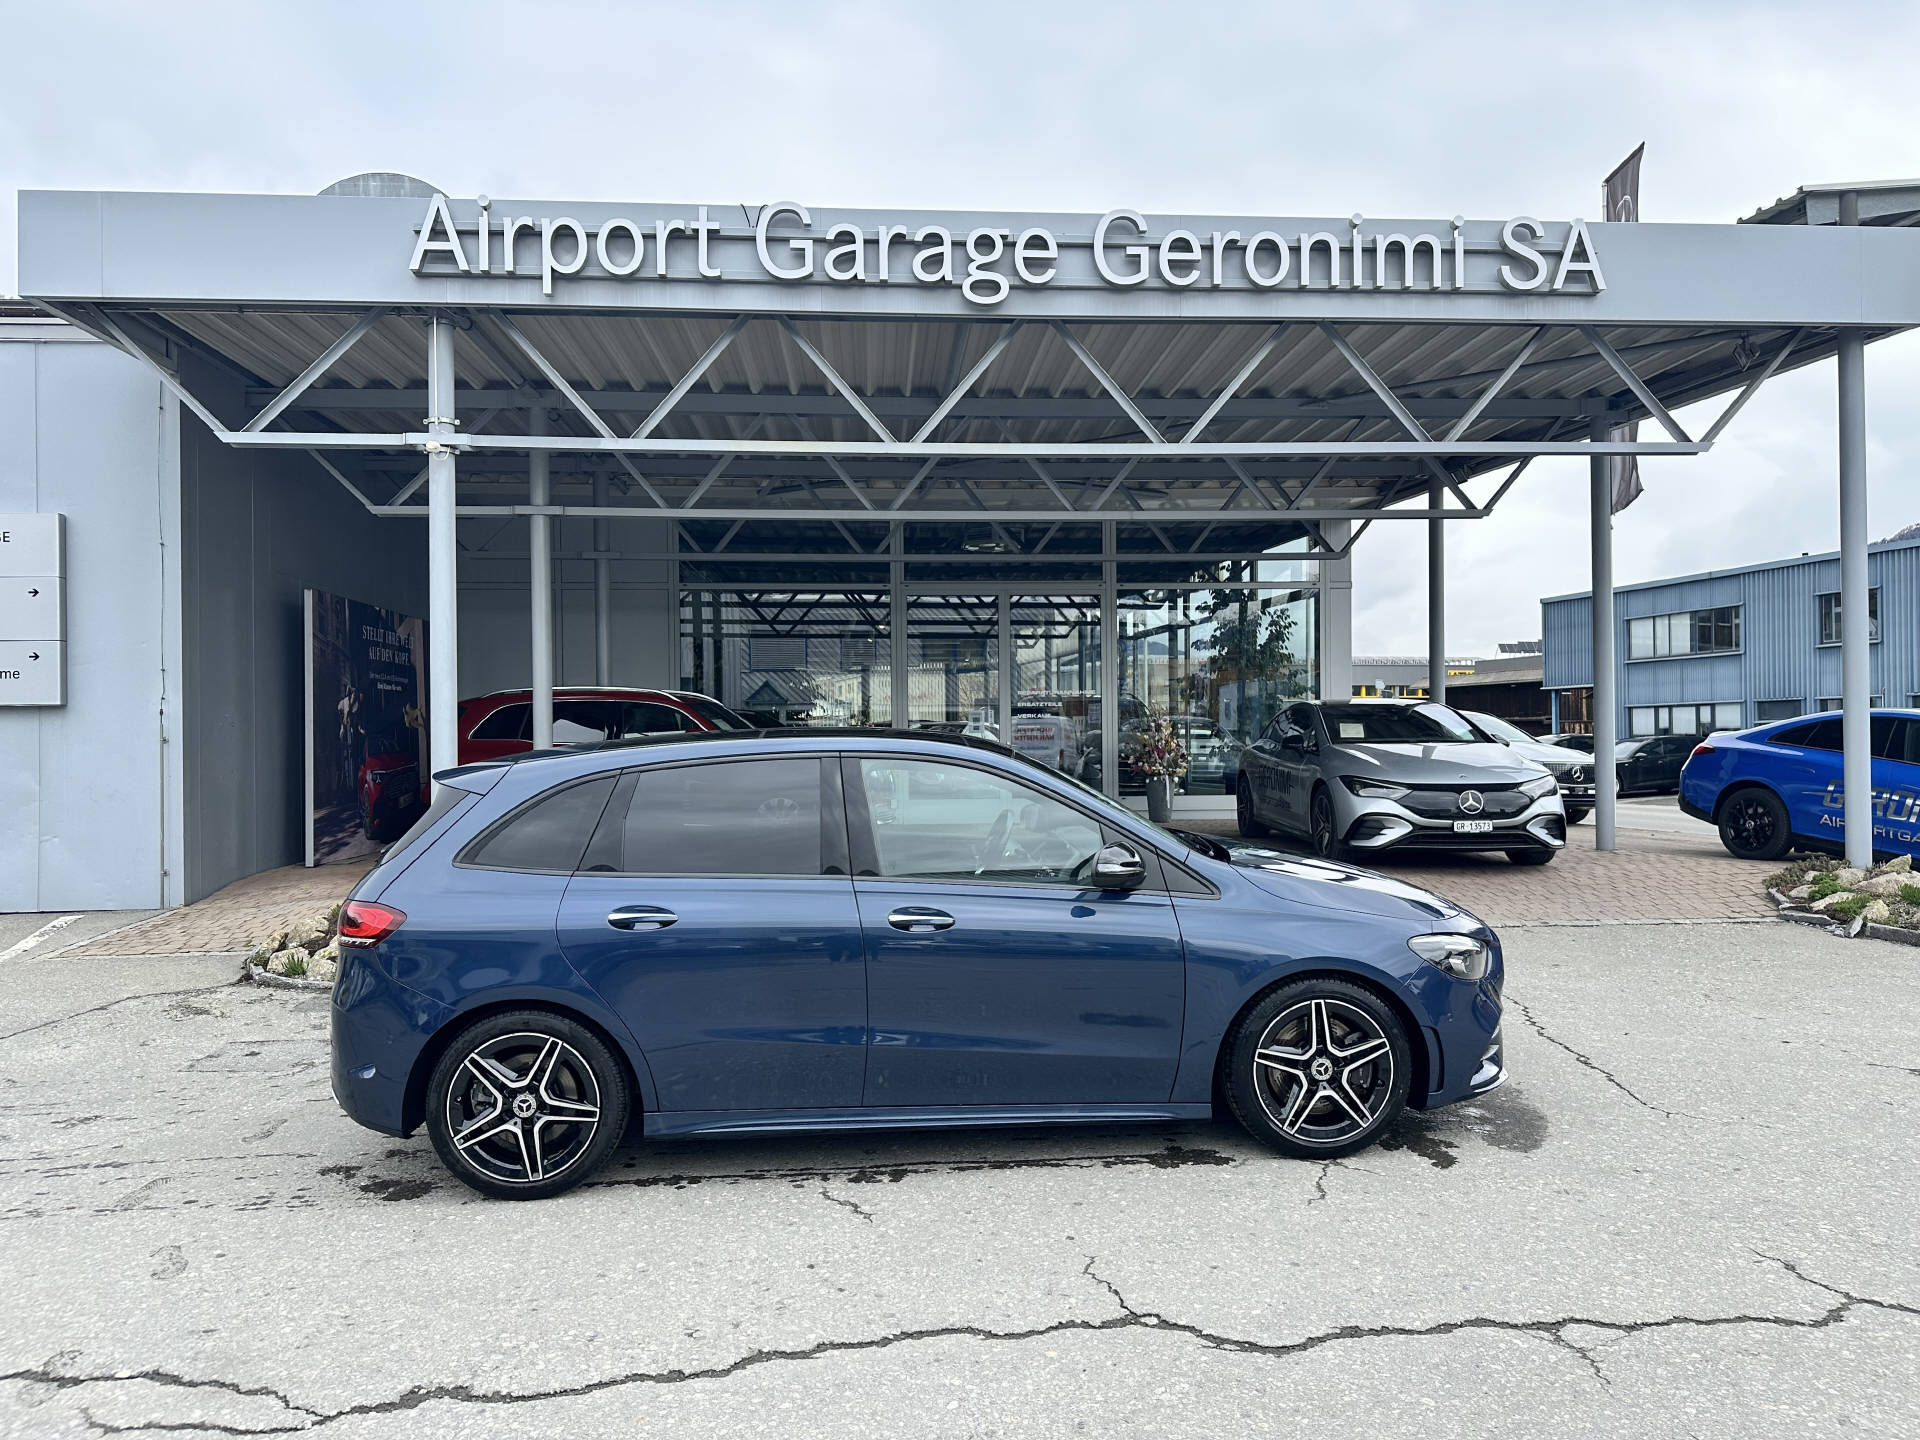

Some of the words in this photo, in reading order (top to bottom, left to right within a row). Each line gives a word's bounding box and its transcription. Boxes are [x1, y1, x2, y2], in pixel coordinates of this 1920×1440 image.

[409, 192, 724, 296] Airport
[755, 200, 1059, 308] Garage
[1091, 208, 1466, 292] Geronimi
[1498, 216, 1607, 295] SA
[1456, 822, 1465, 831] GR
[1469, 822, 1491, 831] 13573
